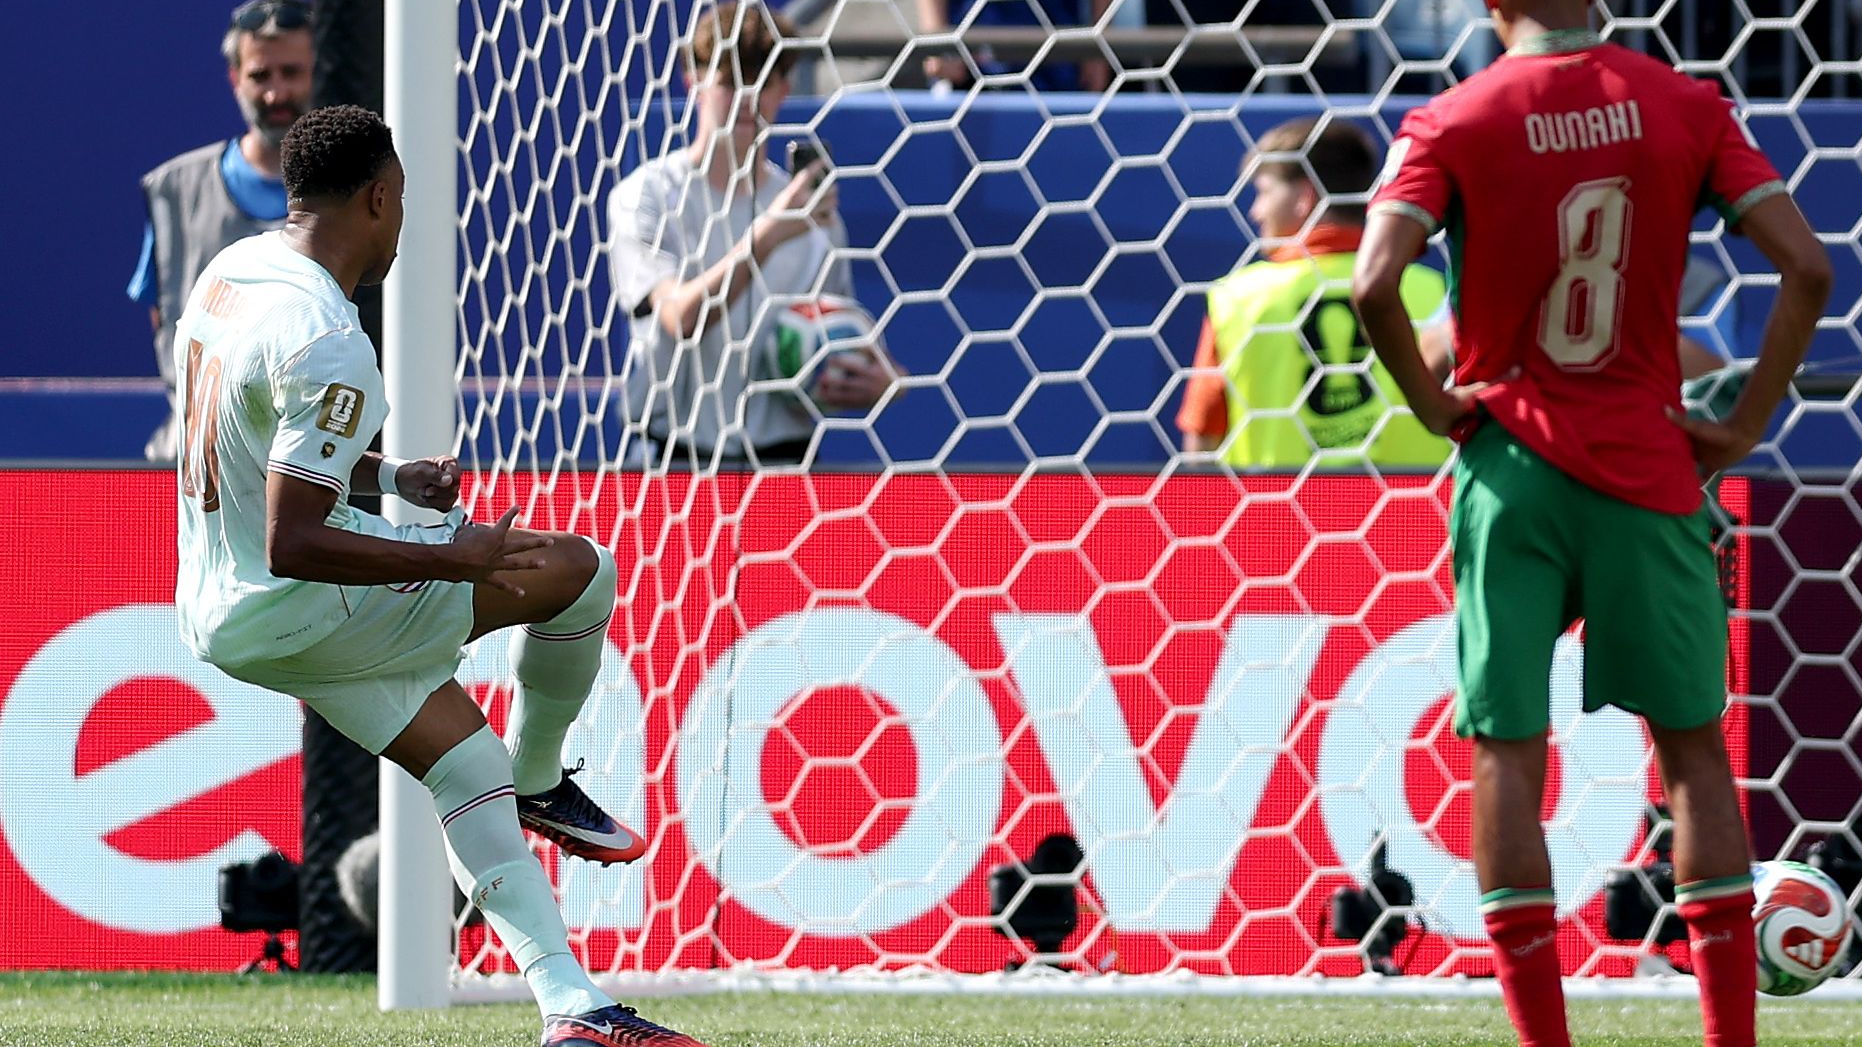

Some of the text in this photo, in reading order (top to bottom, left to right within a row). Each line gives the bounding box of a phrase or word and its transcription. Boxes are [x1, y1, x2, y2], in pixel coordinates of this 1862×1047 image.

[1524, 100, 1643, 153] OUNAHI
[1536, 175, 1634, 373] 8
[183, 337, 222, 513] 10
